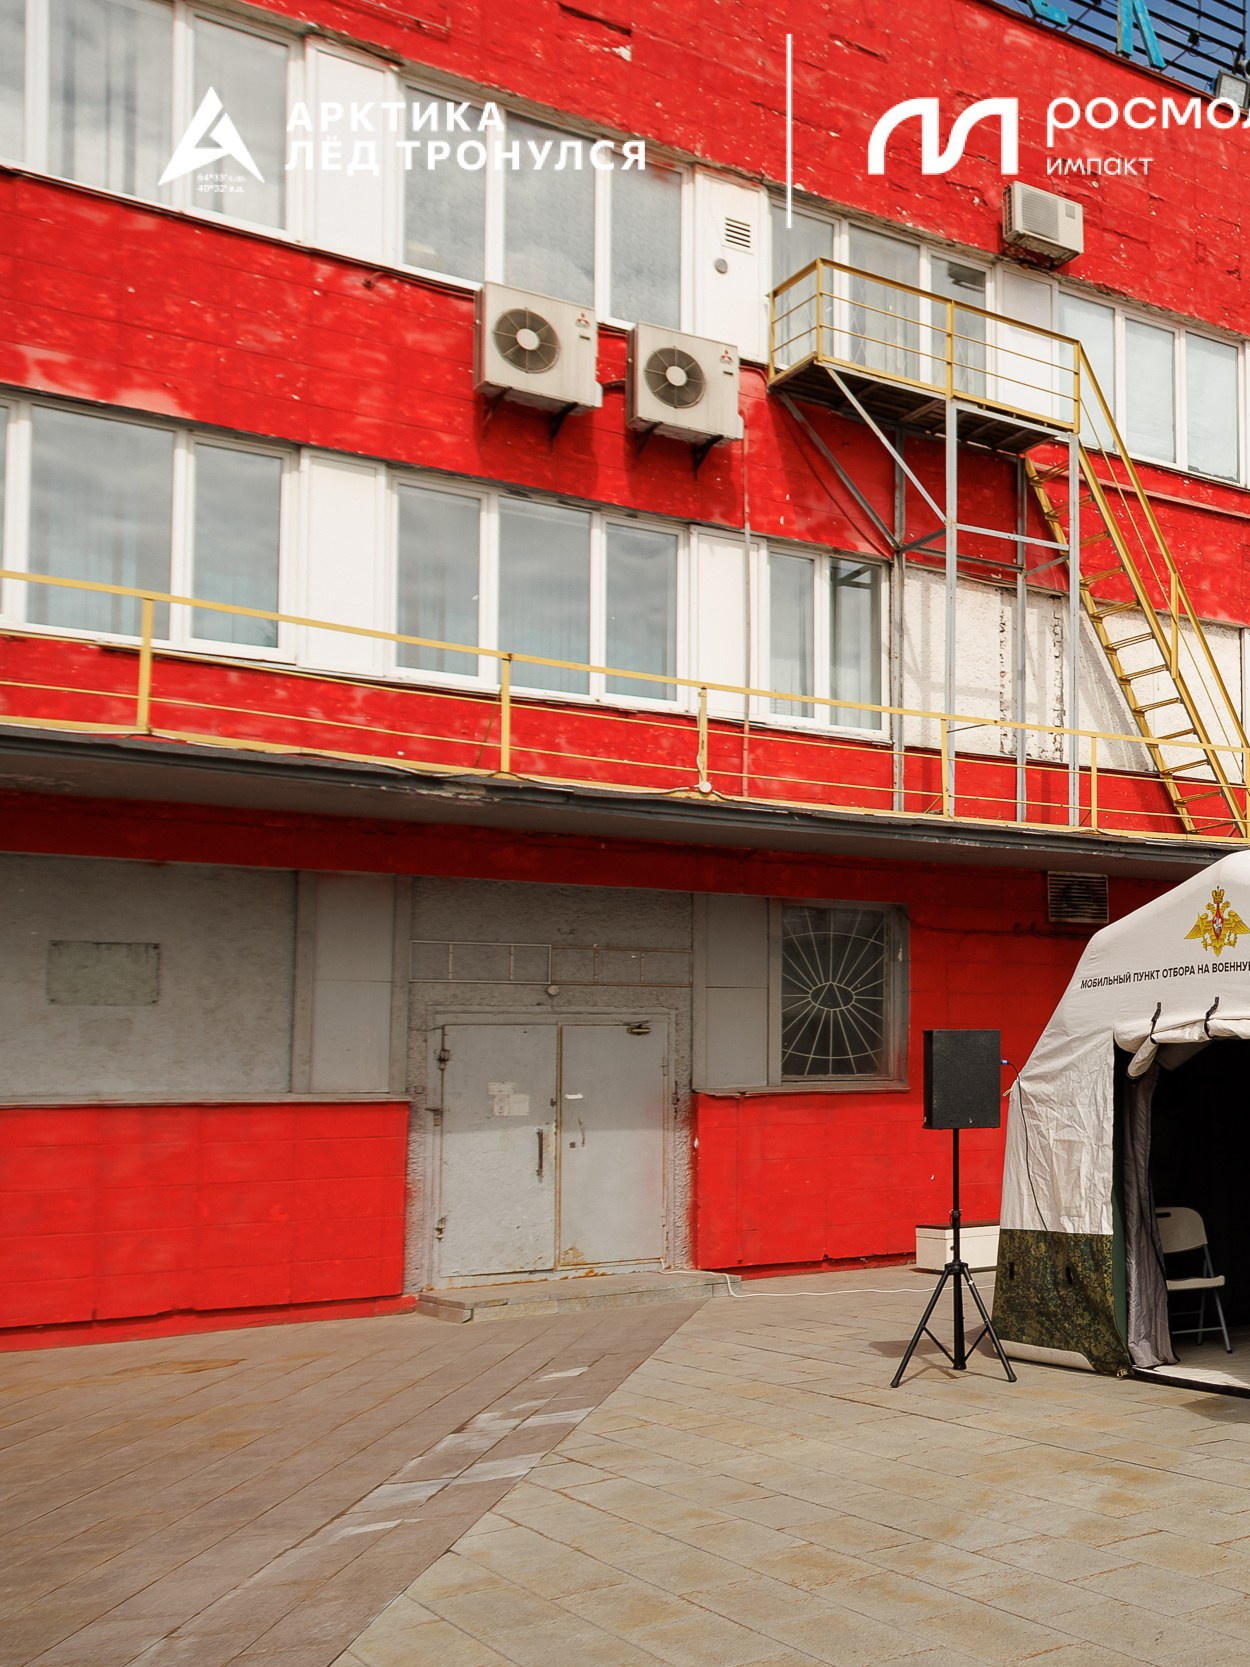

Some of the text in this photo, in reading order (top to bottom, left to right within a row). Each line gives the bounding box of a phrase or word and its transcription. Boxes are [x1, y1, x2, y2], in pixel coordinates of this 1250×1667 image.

[1080, 971, 1132, 989] МОБИЛЬНЫЙ
[1133, 969, 1161, 983] ПУНКТ
[1162, 965, 1196, 980] ОТБОРА
[1197, 963, 1211, 975] НА
